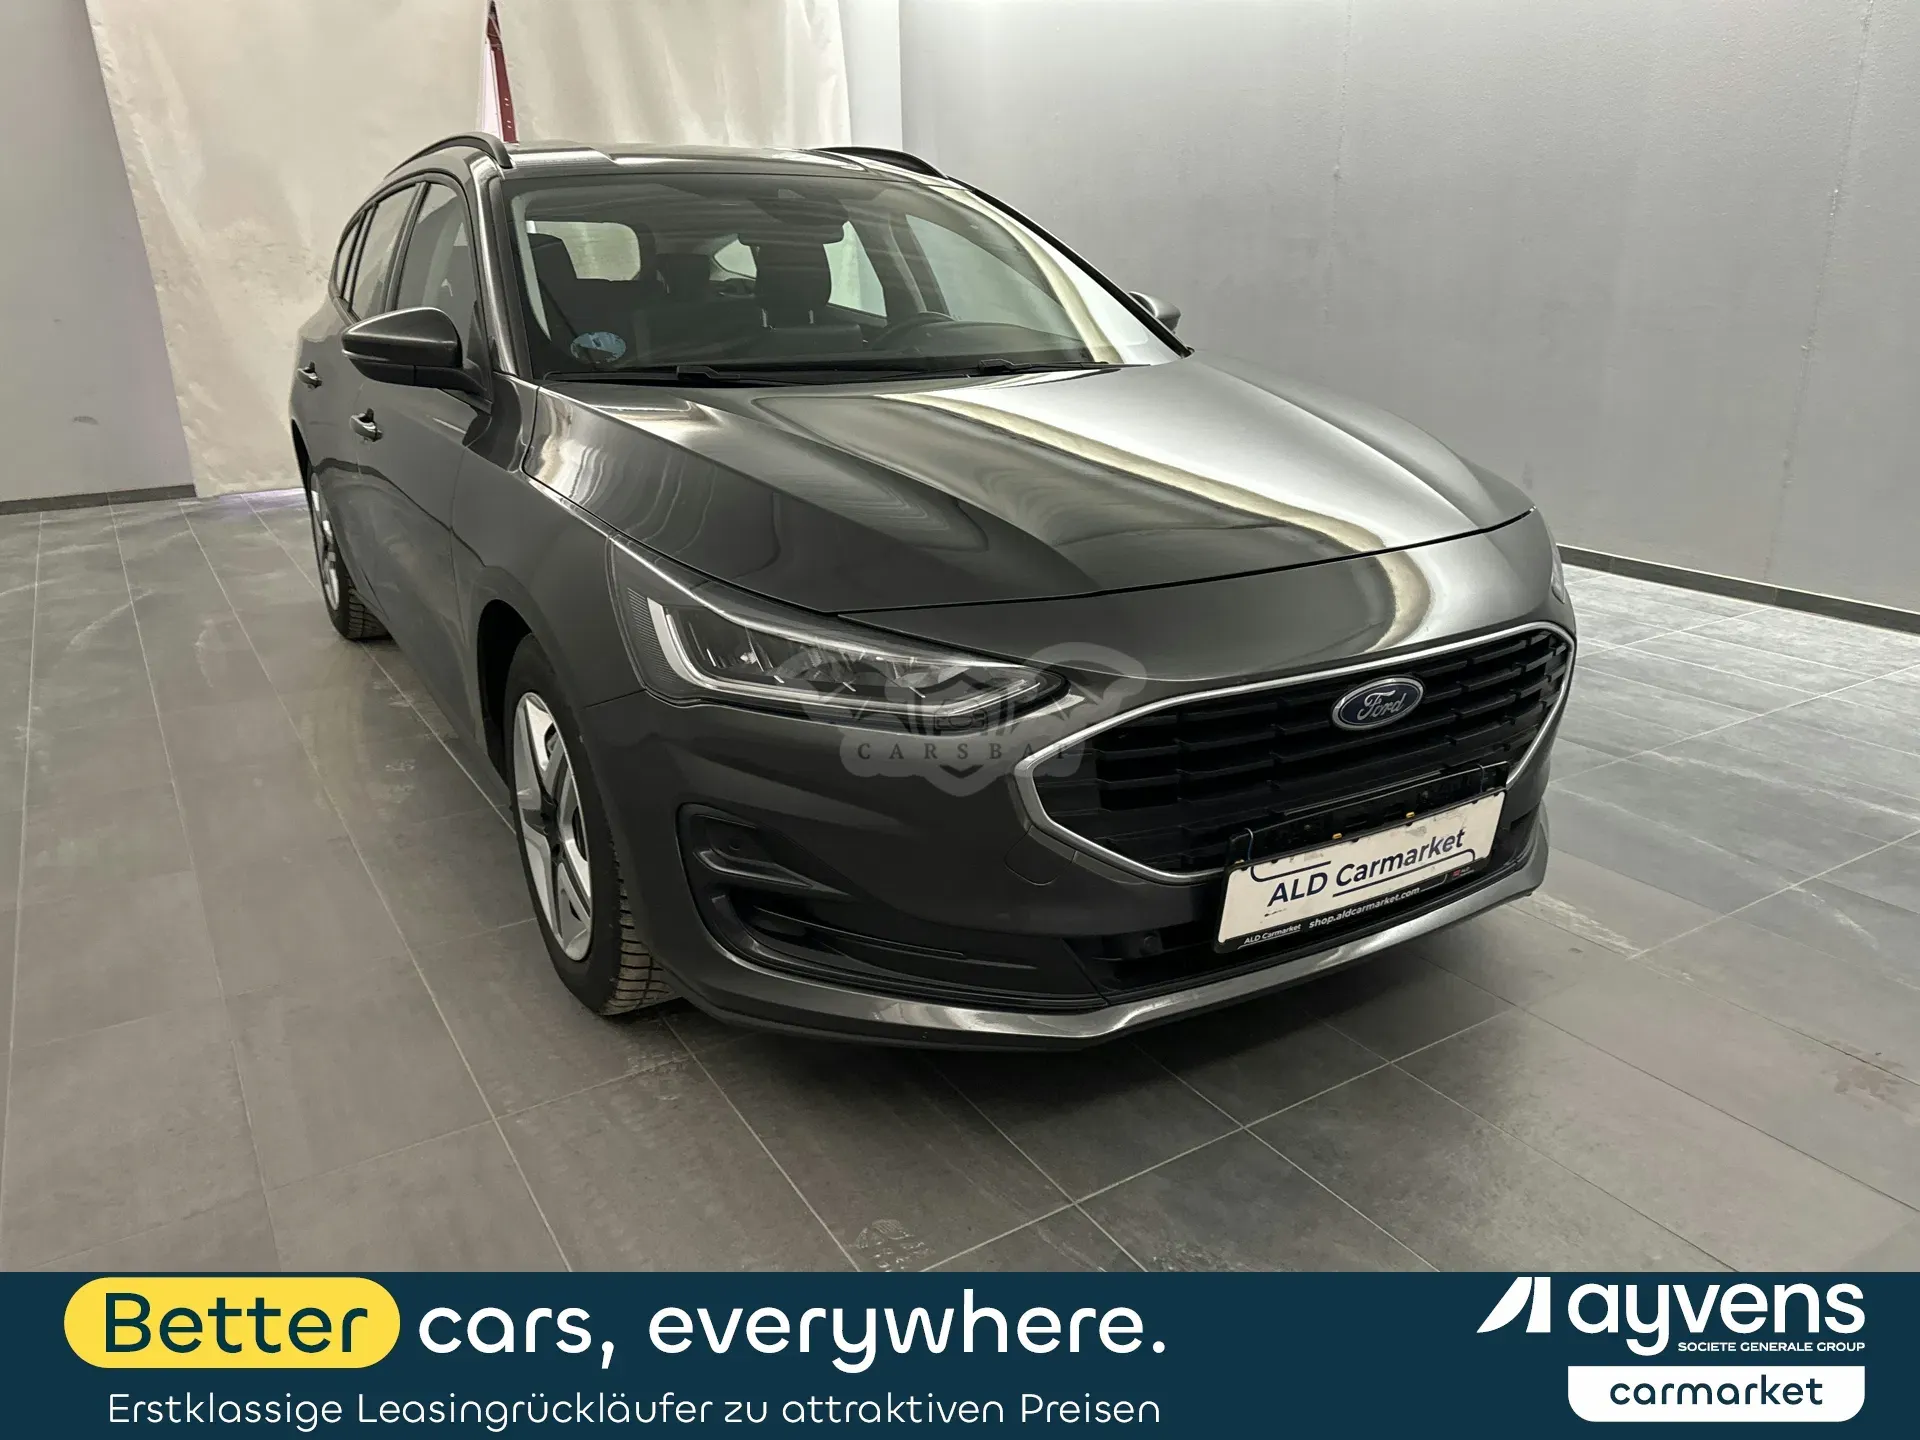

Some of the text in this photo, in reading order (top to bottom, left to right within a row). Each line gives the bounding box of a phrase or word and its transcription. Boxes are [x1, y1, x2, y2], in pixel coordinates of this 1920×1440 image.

[1357, 690, 1407, 720] Ford
[1267, 828, 1465, 907] ALD Carmarket
[1308, 887, 1421, 929] shop.aldcarmarket.com
[1243, 923, 1302, 945] ALD Carmarket
